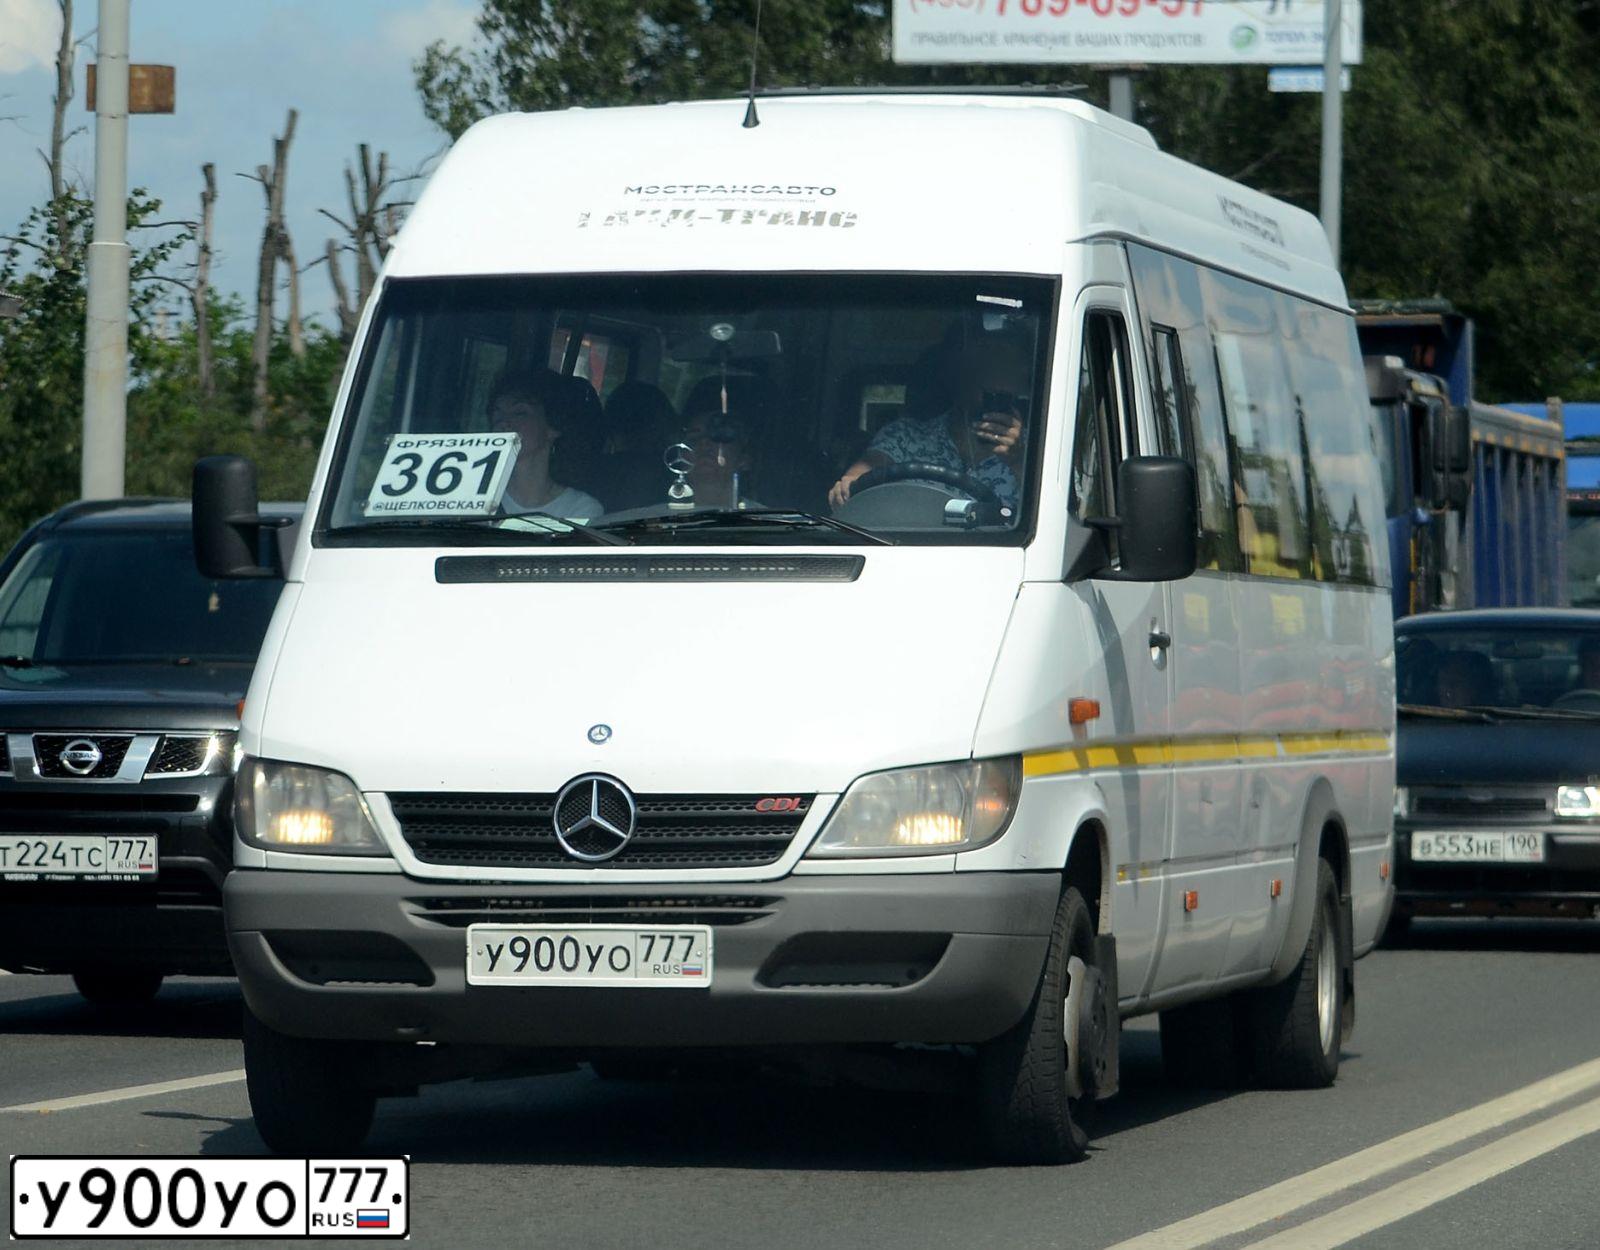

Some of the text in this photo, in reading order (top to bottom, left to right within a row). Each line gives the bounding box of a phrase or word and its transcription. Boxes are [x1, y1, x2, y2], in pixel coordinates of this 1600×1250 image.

[623, 185, 837, 196] МОСТРАНСАВТО
[397, 437, 508, 449] ФРЯЗИНО
[381, 450, 502, 497] 361
[384, 500, 486, 511] ЩЕЛКОВСКАЯ
[755, 797, 802, 812] CDI
[1508, 834, 1538, 850] 190
[0, 839, 148, 867] Т224ТС 777
[485, 934, 695, 973] У900УО 777
[652, 964, 681, 975] RUS
